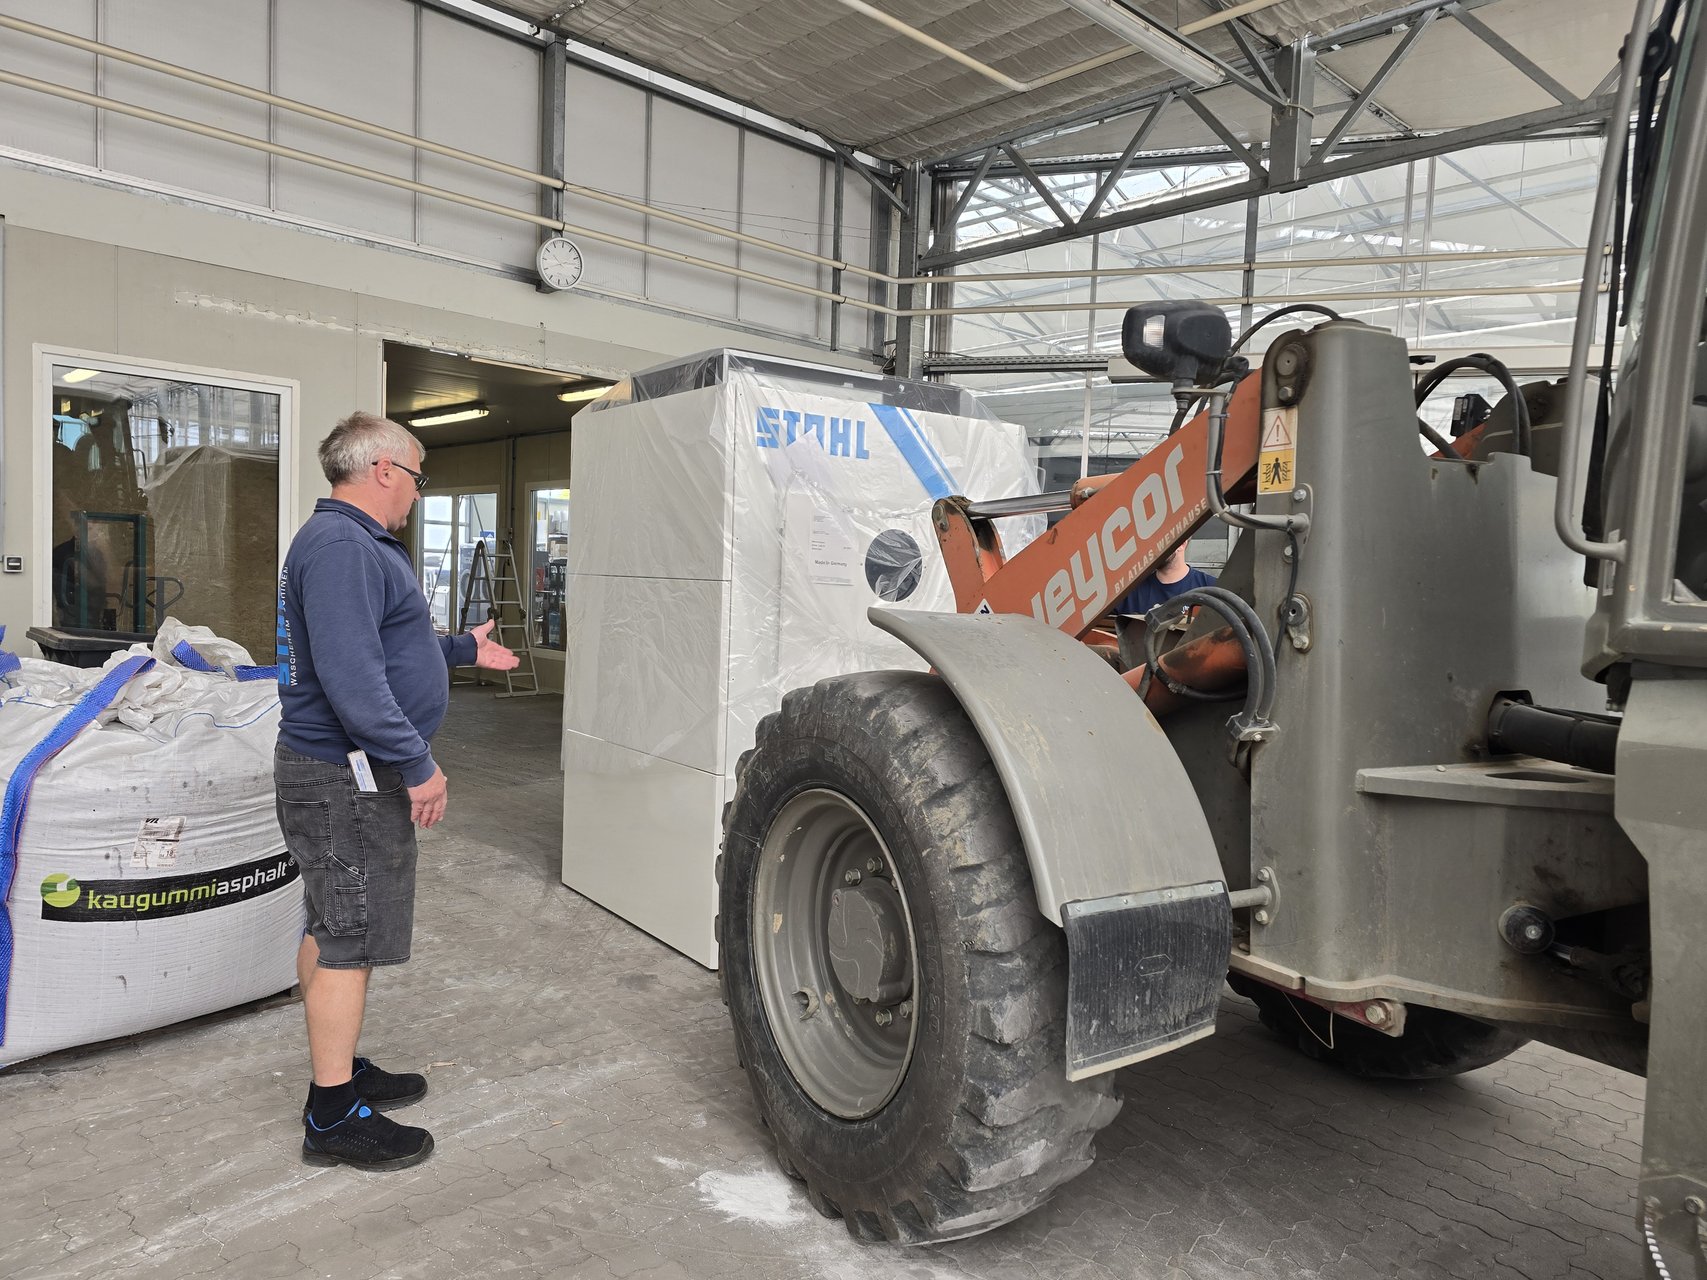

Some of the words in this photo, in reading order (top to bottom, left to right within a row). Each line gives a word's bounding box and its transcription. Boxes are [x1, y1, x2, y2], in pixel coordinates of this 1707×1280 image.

[756, 406, 870, 460] STAHL
[1114, 576, 1125, 594] BY
[1128, 549, 1155, 582] ATLAS
